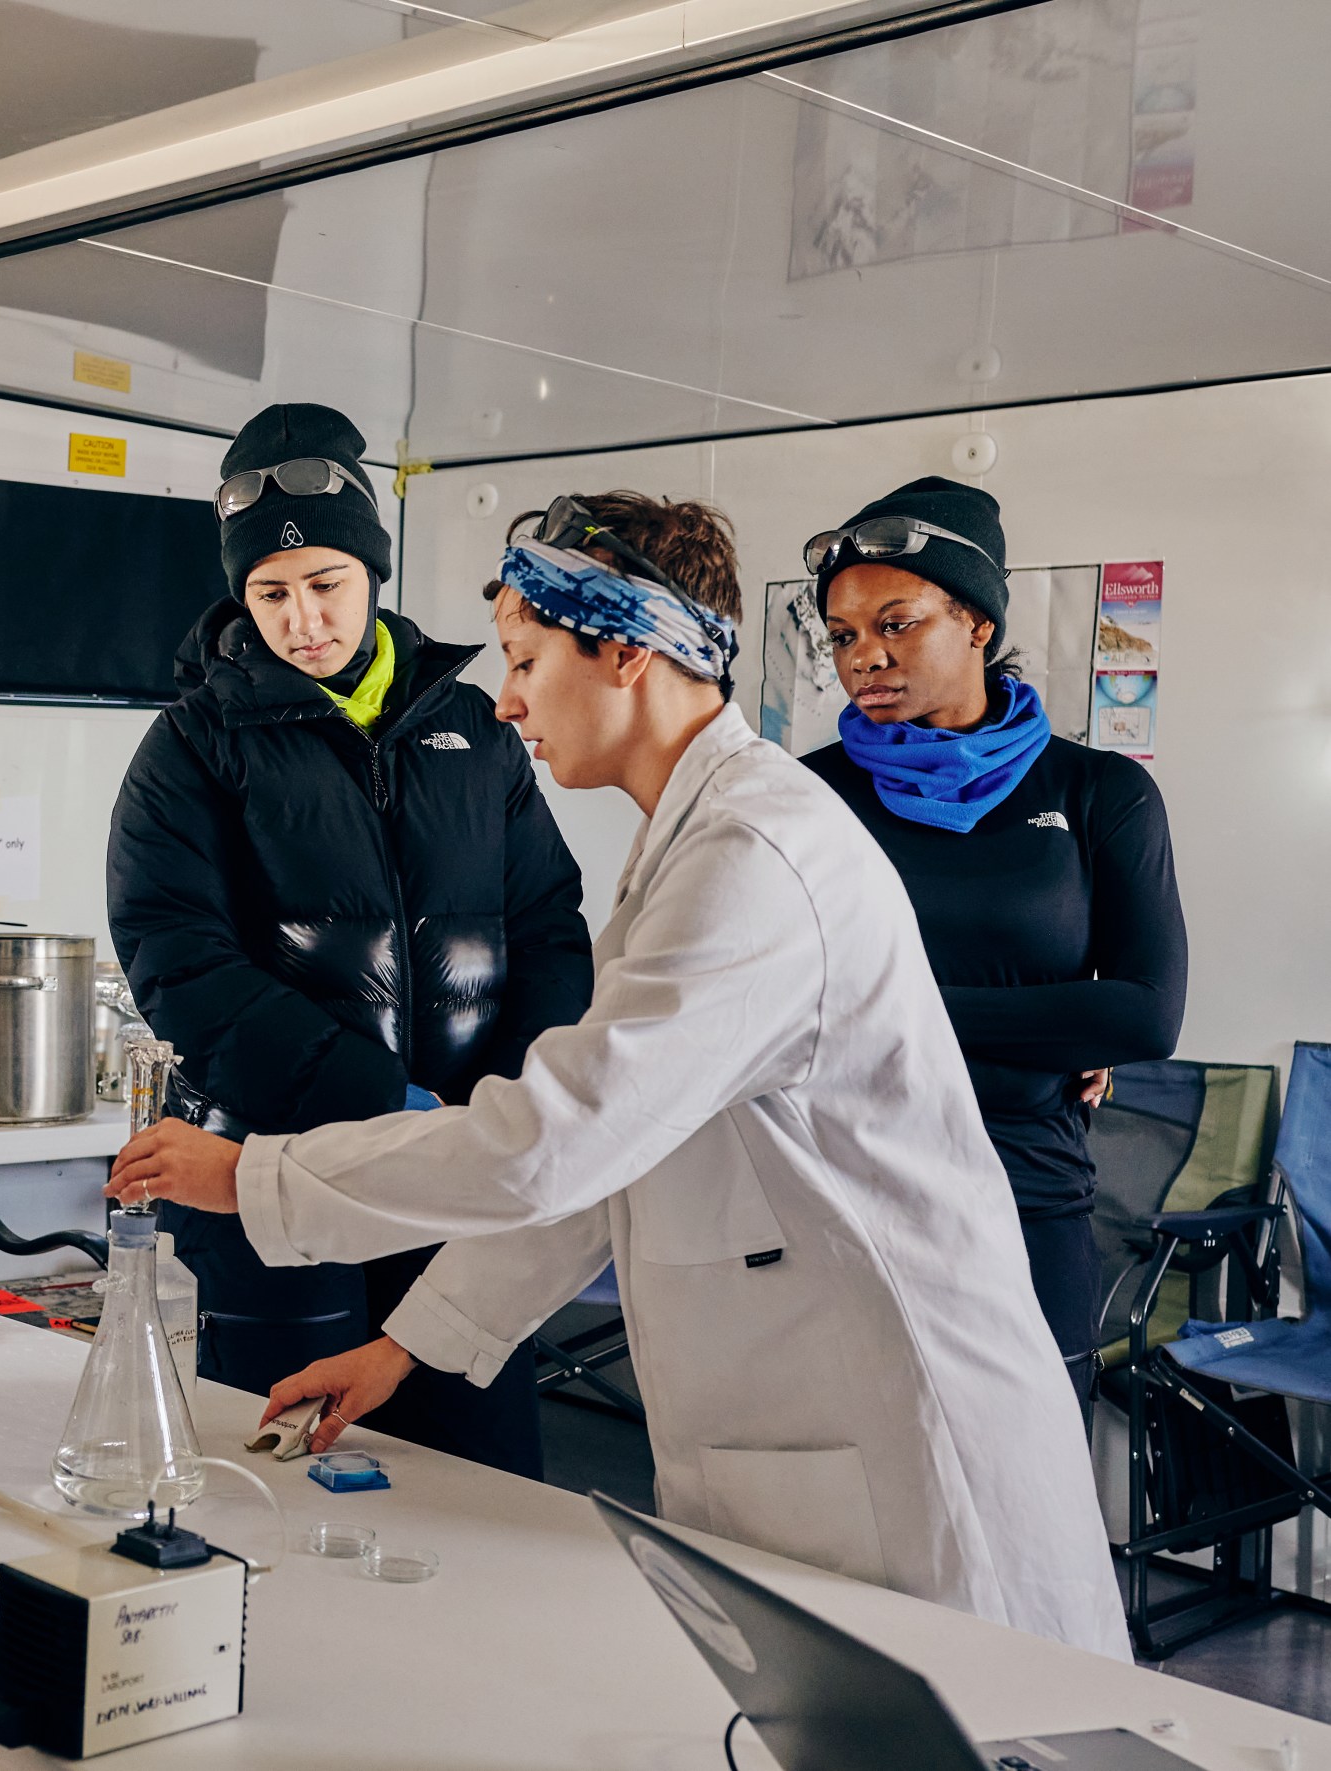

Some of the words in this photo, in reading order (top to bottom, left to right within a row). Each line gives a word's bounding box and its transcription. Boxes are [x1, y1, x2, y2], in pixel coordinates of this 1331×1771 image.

[83, 439, 114, 450] CAUTION
[1105, 580, 1159, 596] Ellsworth
[420, 736, 453, 746] NORTH
[430, 732, 449, 740] THE
[6, 836, 24, 851] only
